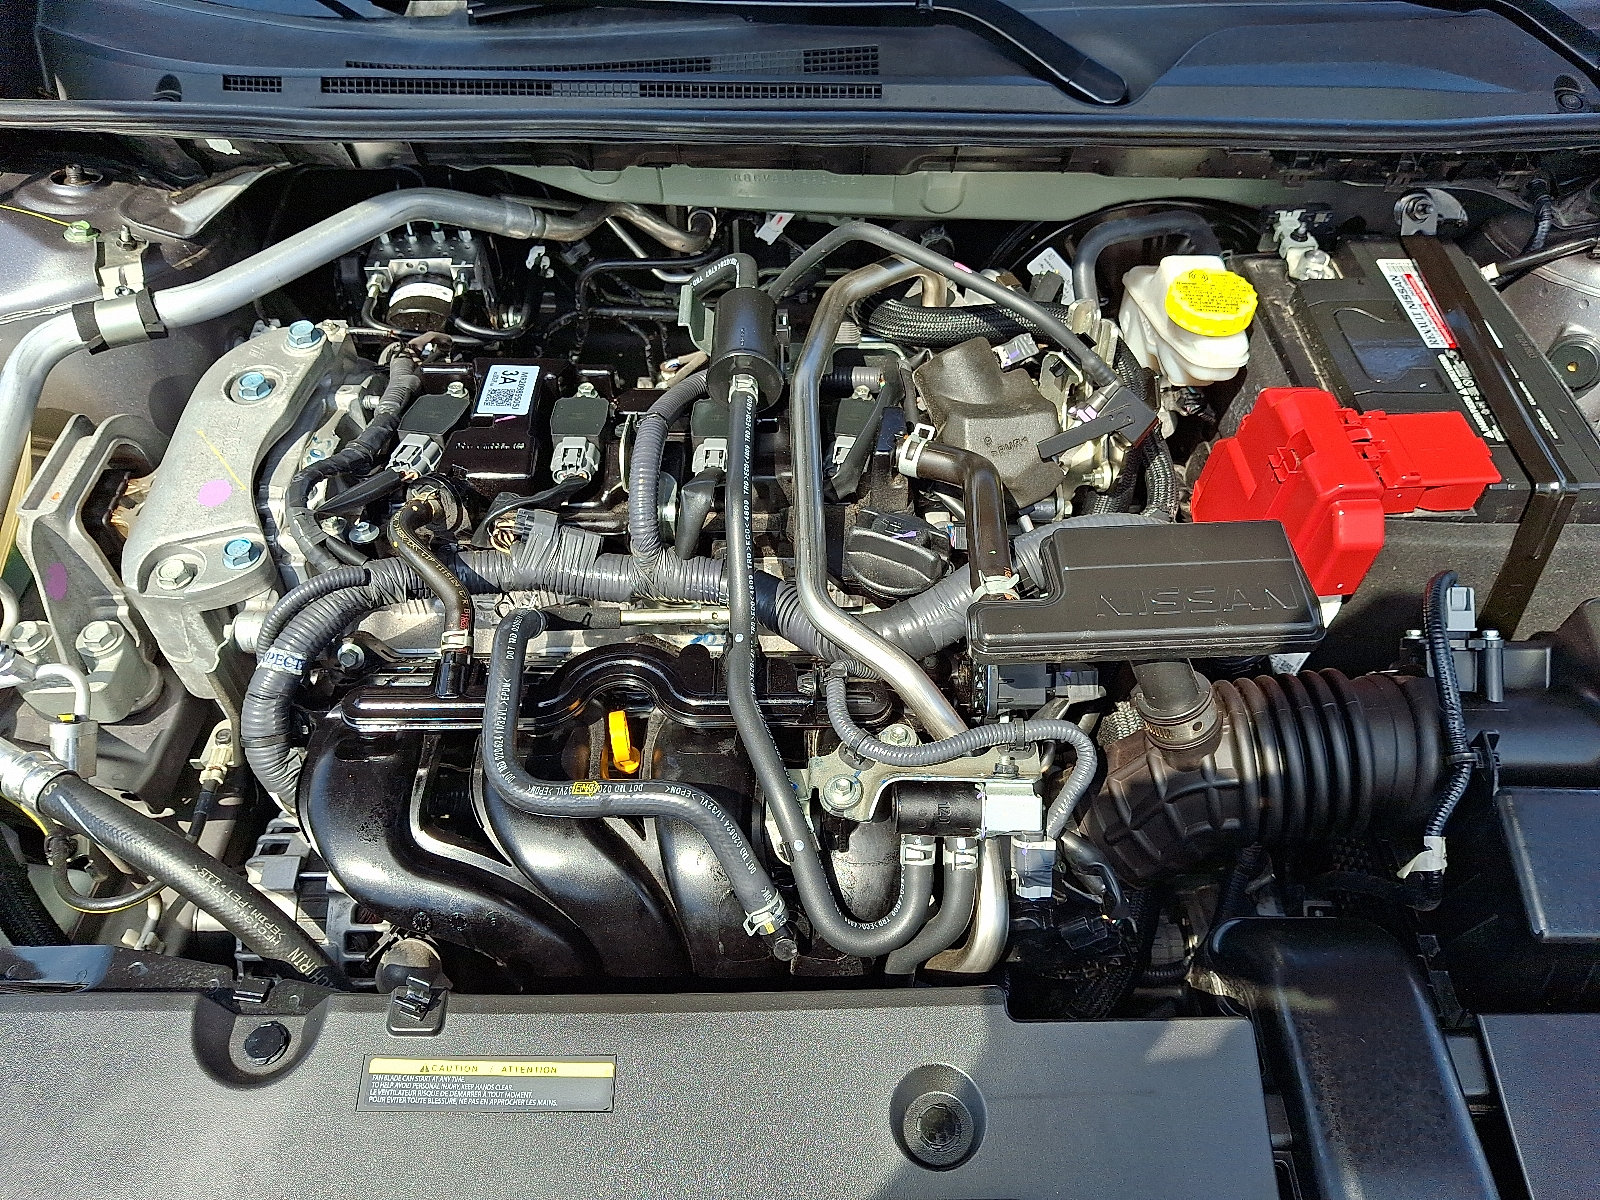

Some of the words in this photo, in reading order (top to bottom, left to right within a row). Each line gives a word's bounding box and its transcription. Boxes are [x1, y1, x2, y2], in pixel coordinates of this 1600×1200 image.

[1389, 274, 1418, 310] NISSAN
[499, 370, 519, 385] 3A
[1096, 583, 1299, 618] NISSAN
[431, 1064, 479, 1073] CAUTION
[501, 1065, 557, 1074] ATTENTION
[372, 1074, 384, 1082] FAN
[415, 1075, 432, 1083] START
[432, 1075, 440, 1083] AT
[372, 1081, 380, 1089] TO
[370, 1088, 378, 1096] LE
[378, 1089, 417, 1097] VENTILATEUR
[417, 1090, 439, 1098] RISQUE
[407, 1097, 427, 1105] TOUTE
[459, 1098, 468, 1106] NE
[468, 1098, 479, 1106] PAS
[489, 1099, 525, 1107] APPROCHER
[525, 1099, 537, 1107] LES
